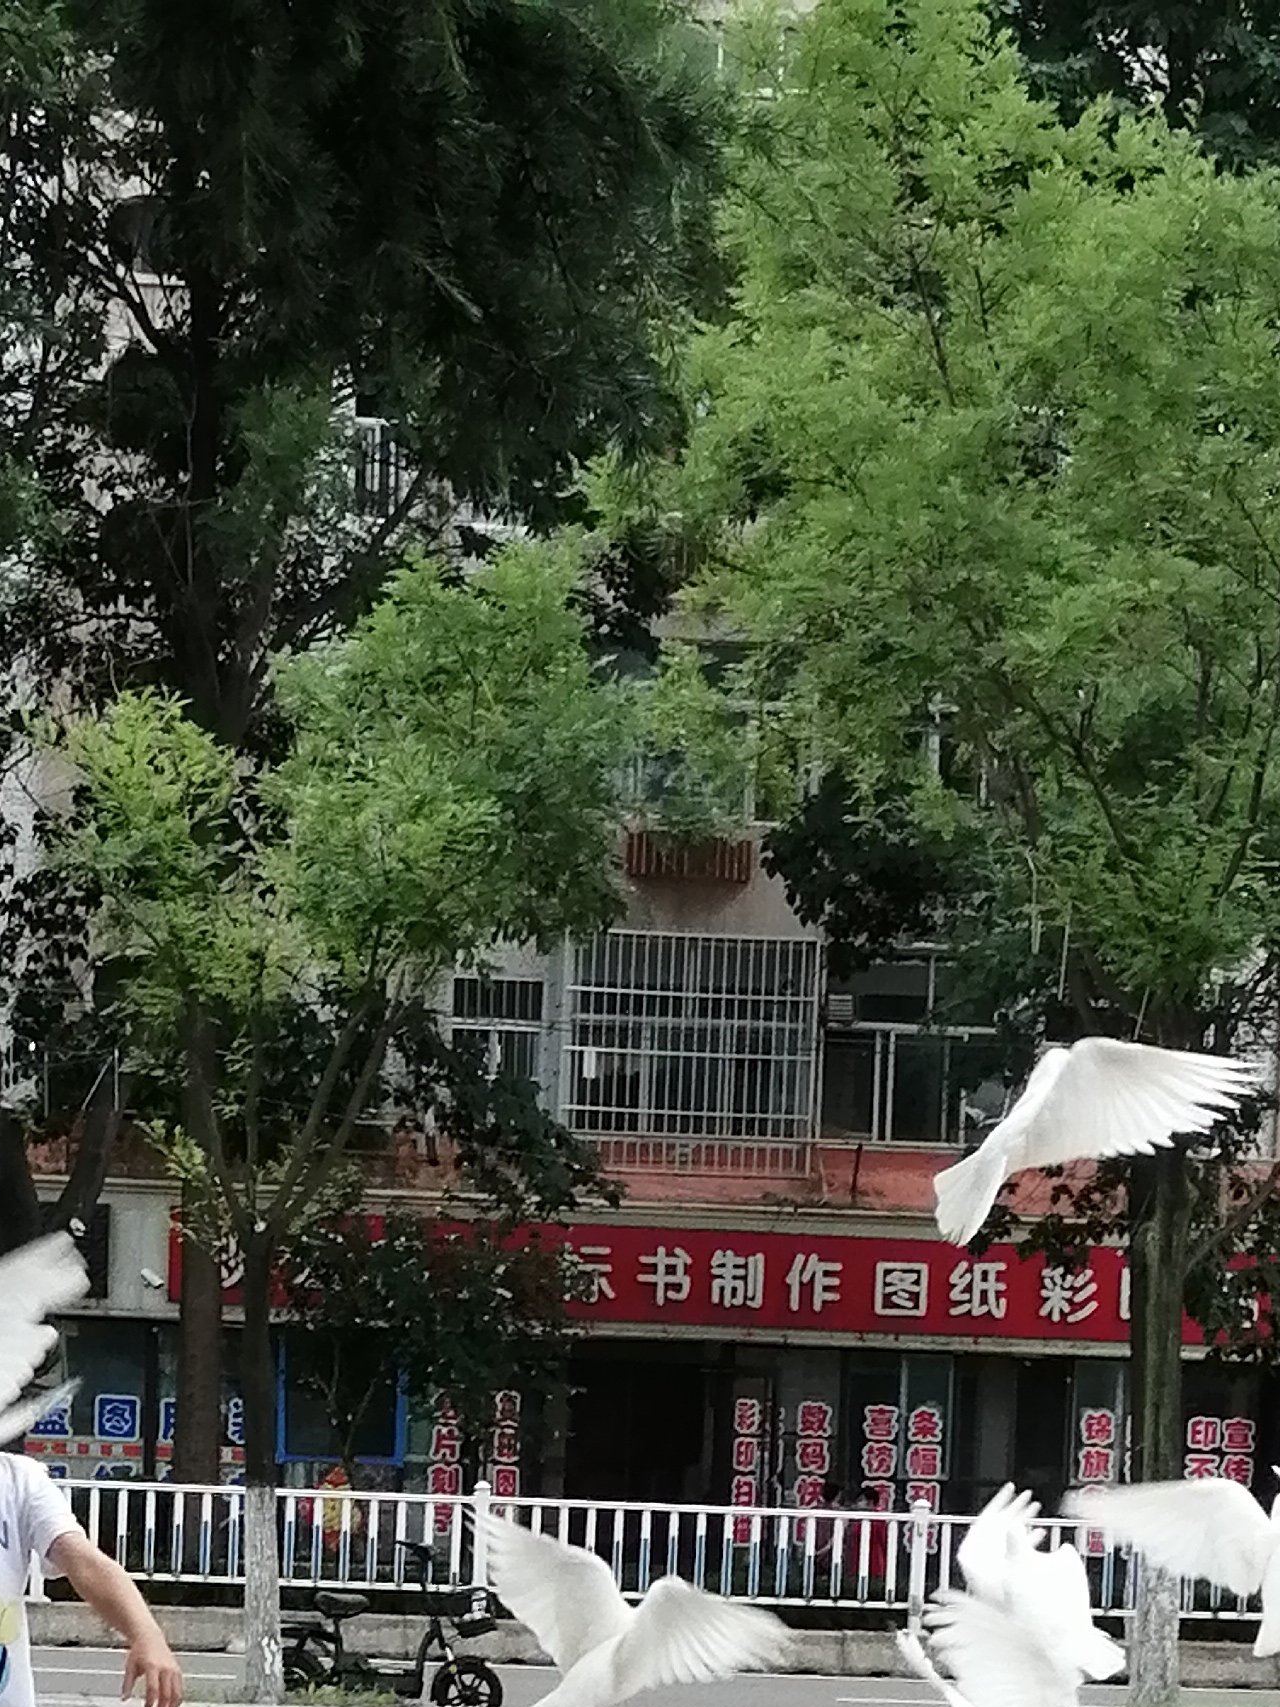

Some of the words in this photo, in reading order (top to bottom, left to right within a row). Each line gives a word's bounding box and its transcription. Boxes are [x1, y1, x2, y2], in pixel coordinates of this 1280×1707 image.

[566, 1244, 1132, 1323] 书制作图纸彩
